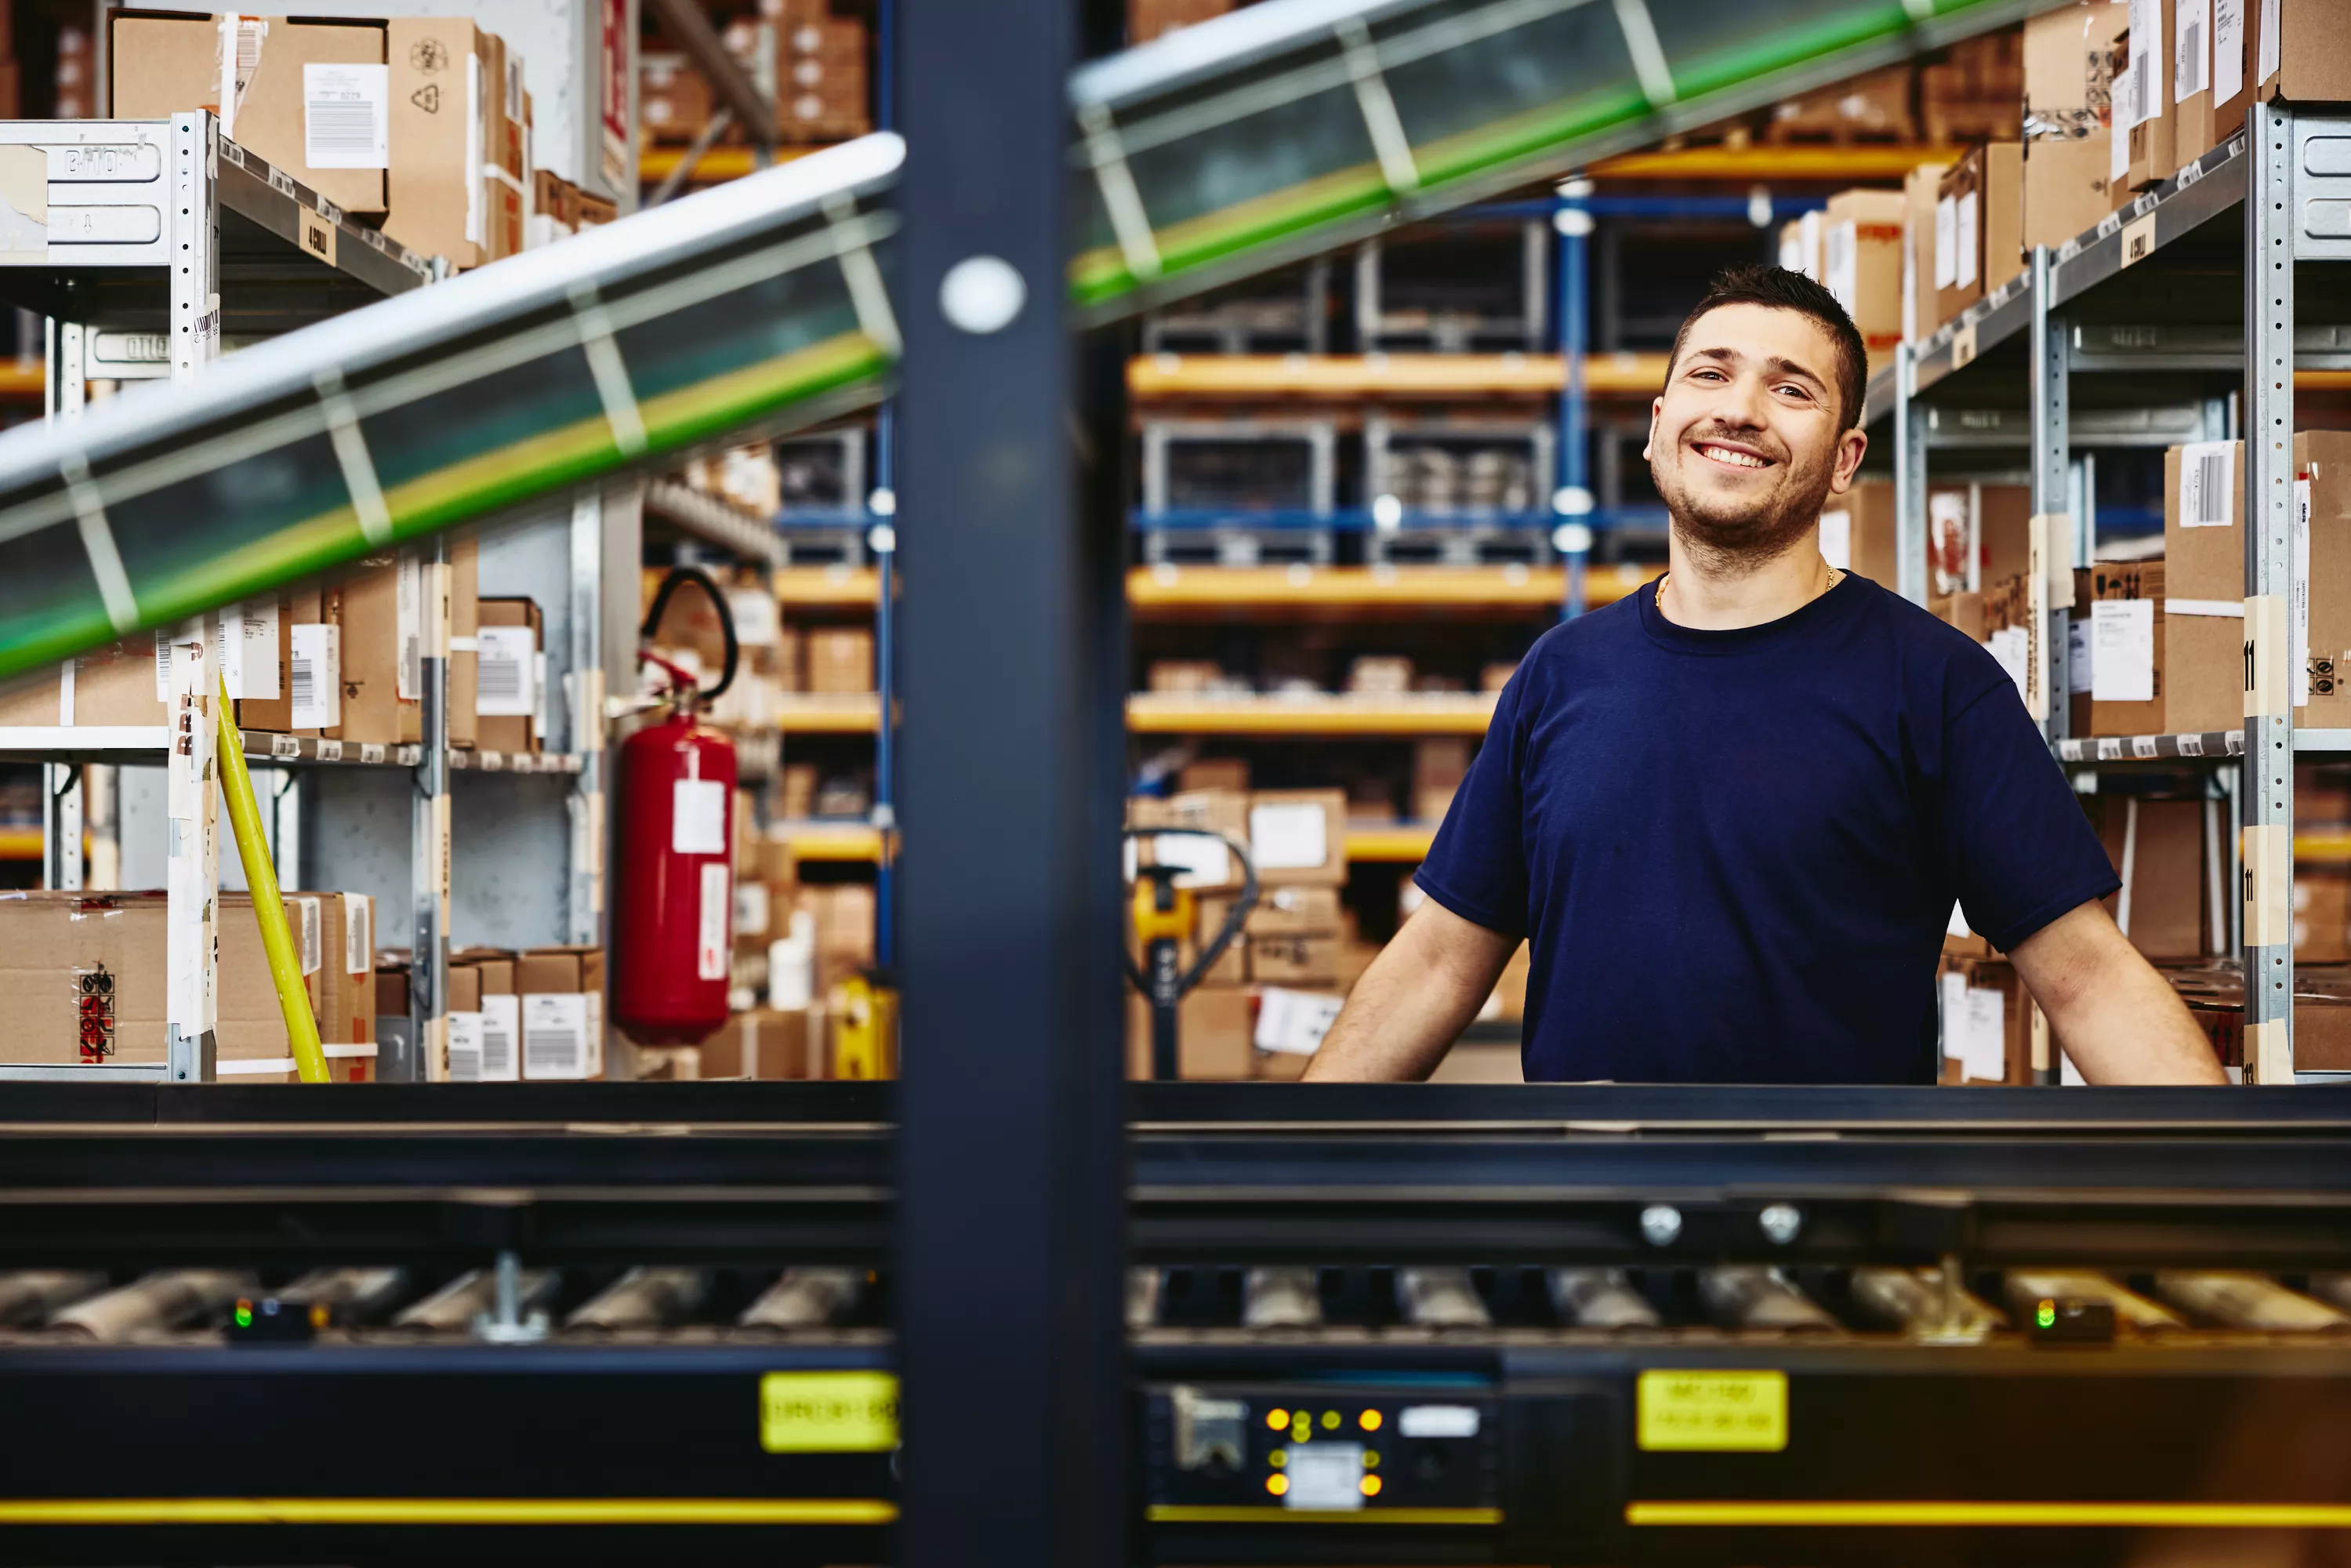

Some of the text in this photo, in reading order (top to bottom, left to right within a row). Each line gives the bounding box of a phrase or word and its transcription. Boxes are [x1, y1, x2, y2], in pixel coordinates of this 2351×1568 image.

[308, 225, 327, 256] 4 COLLI
[2130, 239, 2134, 262] 4
[2244, 639, 2255, 691] 11
[2244, 868, 2253, 902] 11
